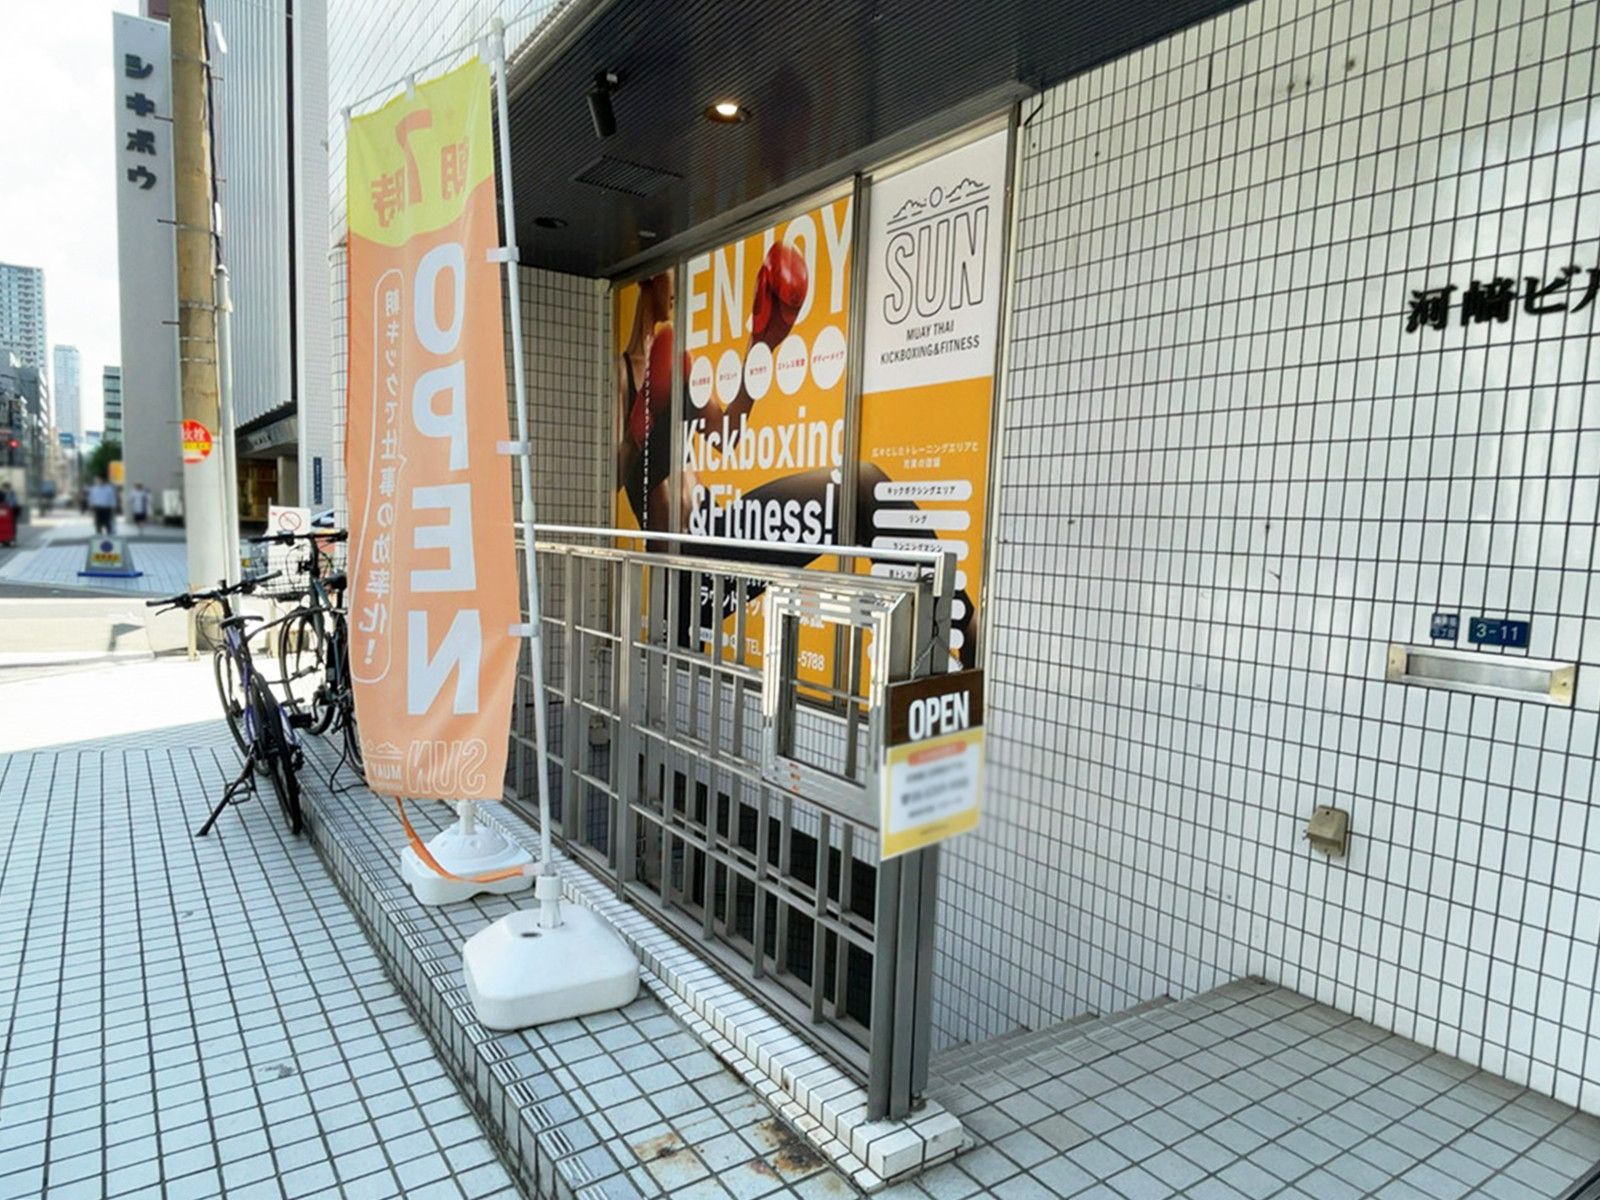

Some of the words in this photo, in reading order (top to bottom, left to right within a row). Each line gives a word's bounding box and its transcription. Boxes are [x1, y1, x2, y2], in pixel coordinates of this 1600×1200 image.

[883, 205, 989, 325] SUN
[880, 335, 980, 365] KICKBOXING&FITNESS
[905, 322, 932, 341] MUAY
[932, 319, 955, 337] THAI
[682, 406, 845, 484] Kickboxing
[688, 483, 835, 545] &Fitness!
[907, 515, 928, 524] リング
[1476, 624, 1518, 641] 3-11
[908, 690, 970, 741] OPEN
